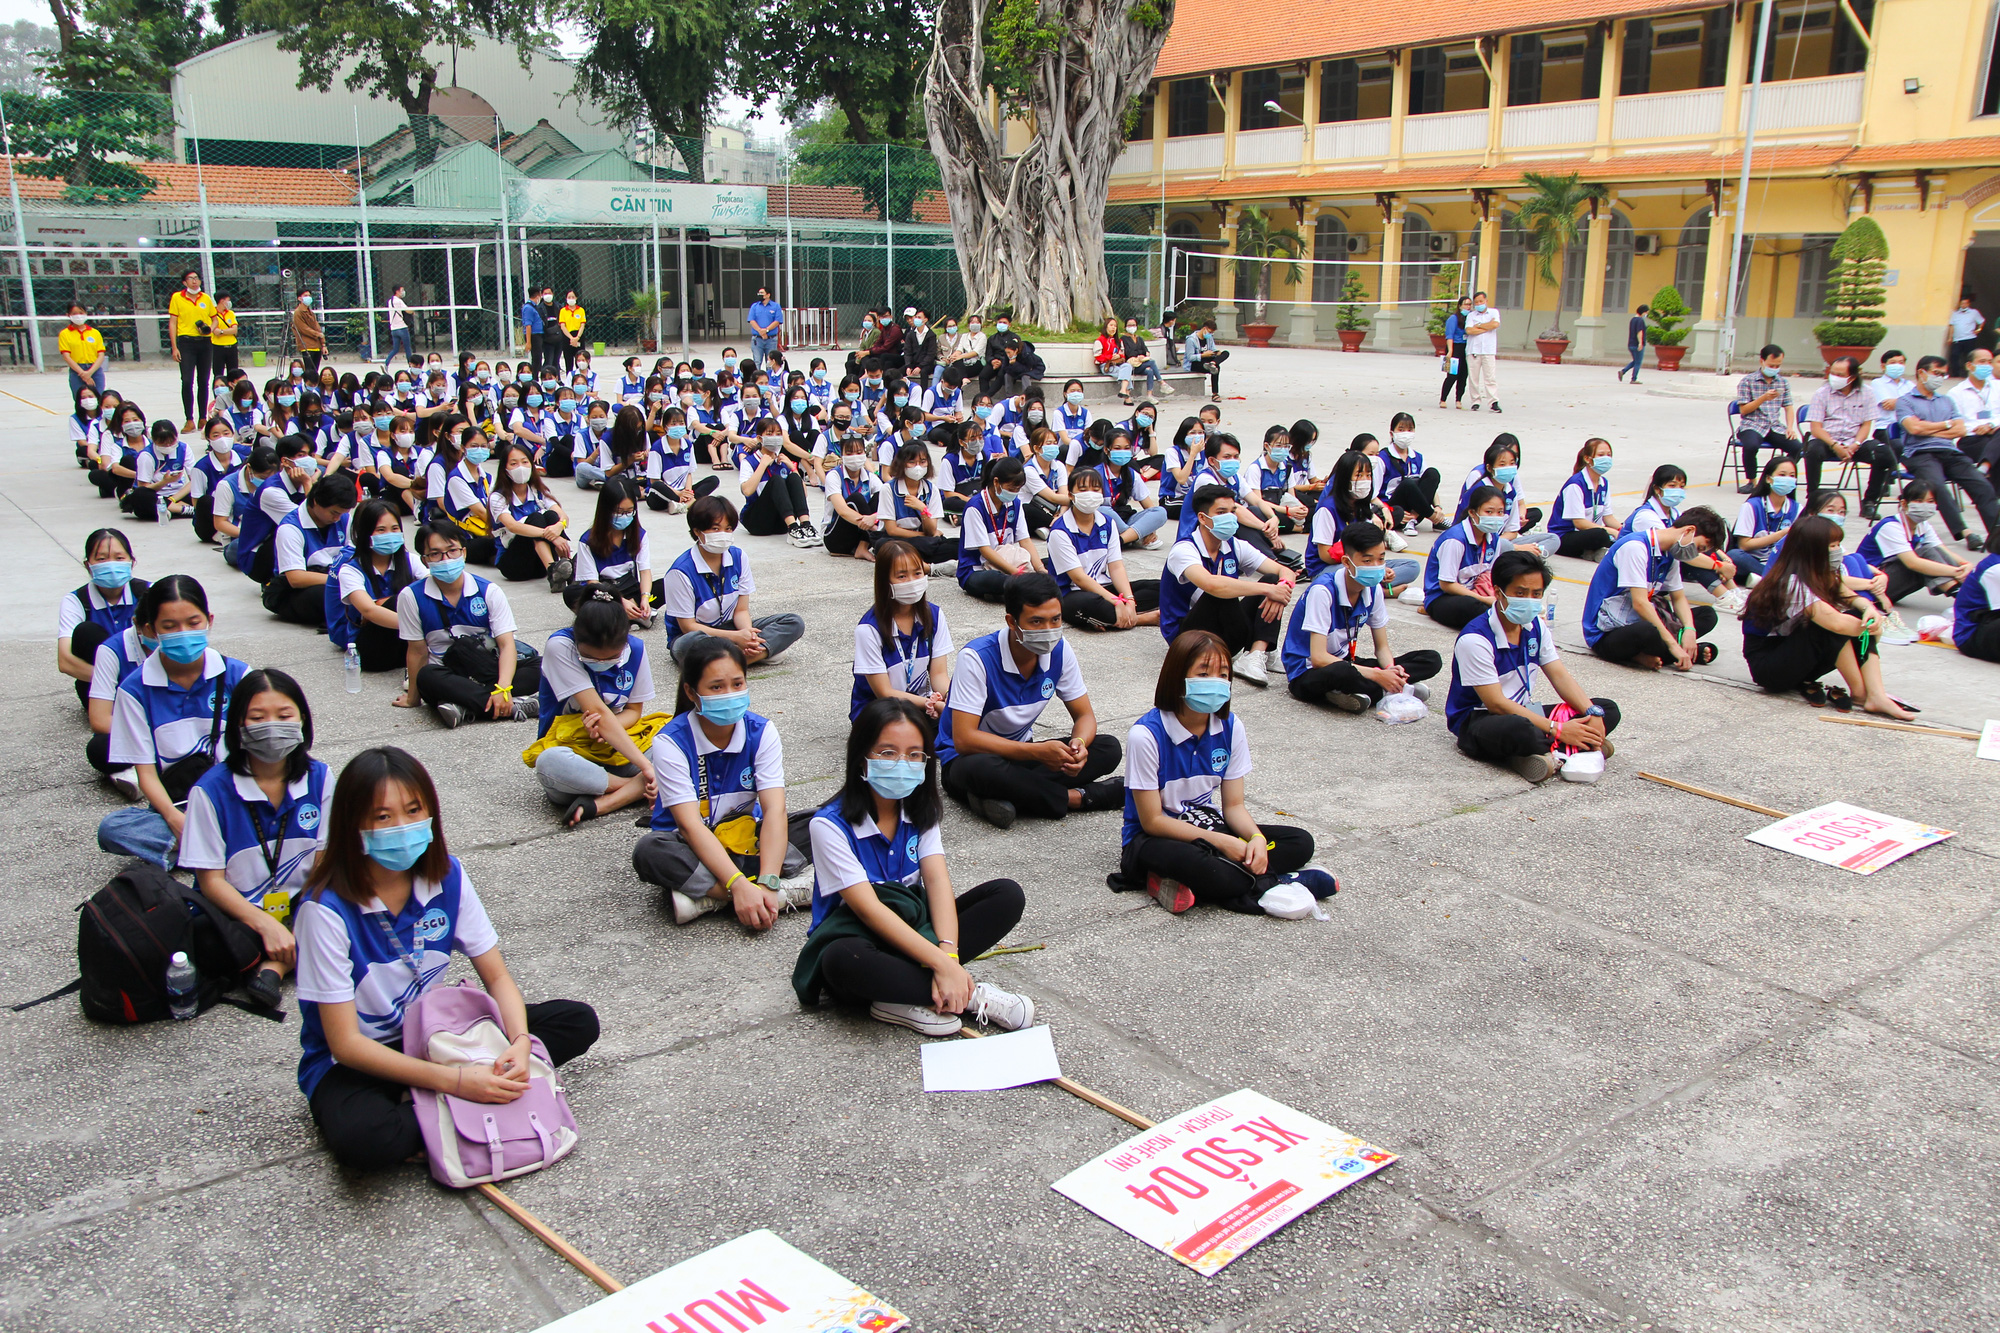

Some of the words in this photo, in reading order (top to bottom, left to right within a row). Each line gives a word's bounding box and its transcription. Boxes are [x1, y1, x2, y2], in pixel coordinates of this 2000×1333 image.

[610, 194, 646, 212] CĂN
[716, 191, 744, 204] Tropicana
[472, 602, 486, 611] SGU
[617, 676, 632, 684] SU
[1042, 683, 1053, 691] SGU
[1211, 755, 1227, 764] SGU
[299, 810, 318, 821] SGU
[1843, 814, 1893, 829] XE
[1793, 832, 1846, 851] 03
[423, 917, 446, 931] SGU
[1230, 1115, 1310, 1153] XE
[1128, 1133, 1176, 1160] NGHỆ
[1181, 1136, 1264, 1191] SỐ
[1339, 1159, 1360, 1171] SGU
[1124, 1166, 1209, 1215] 04
